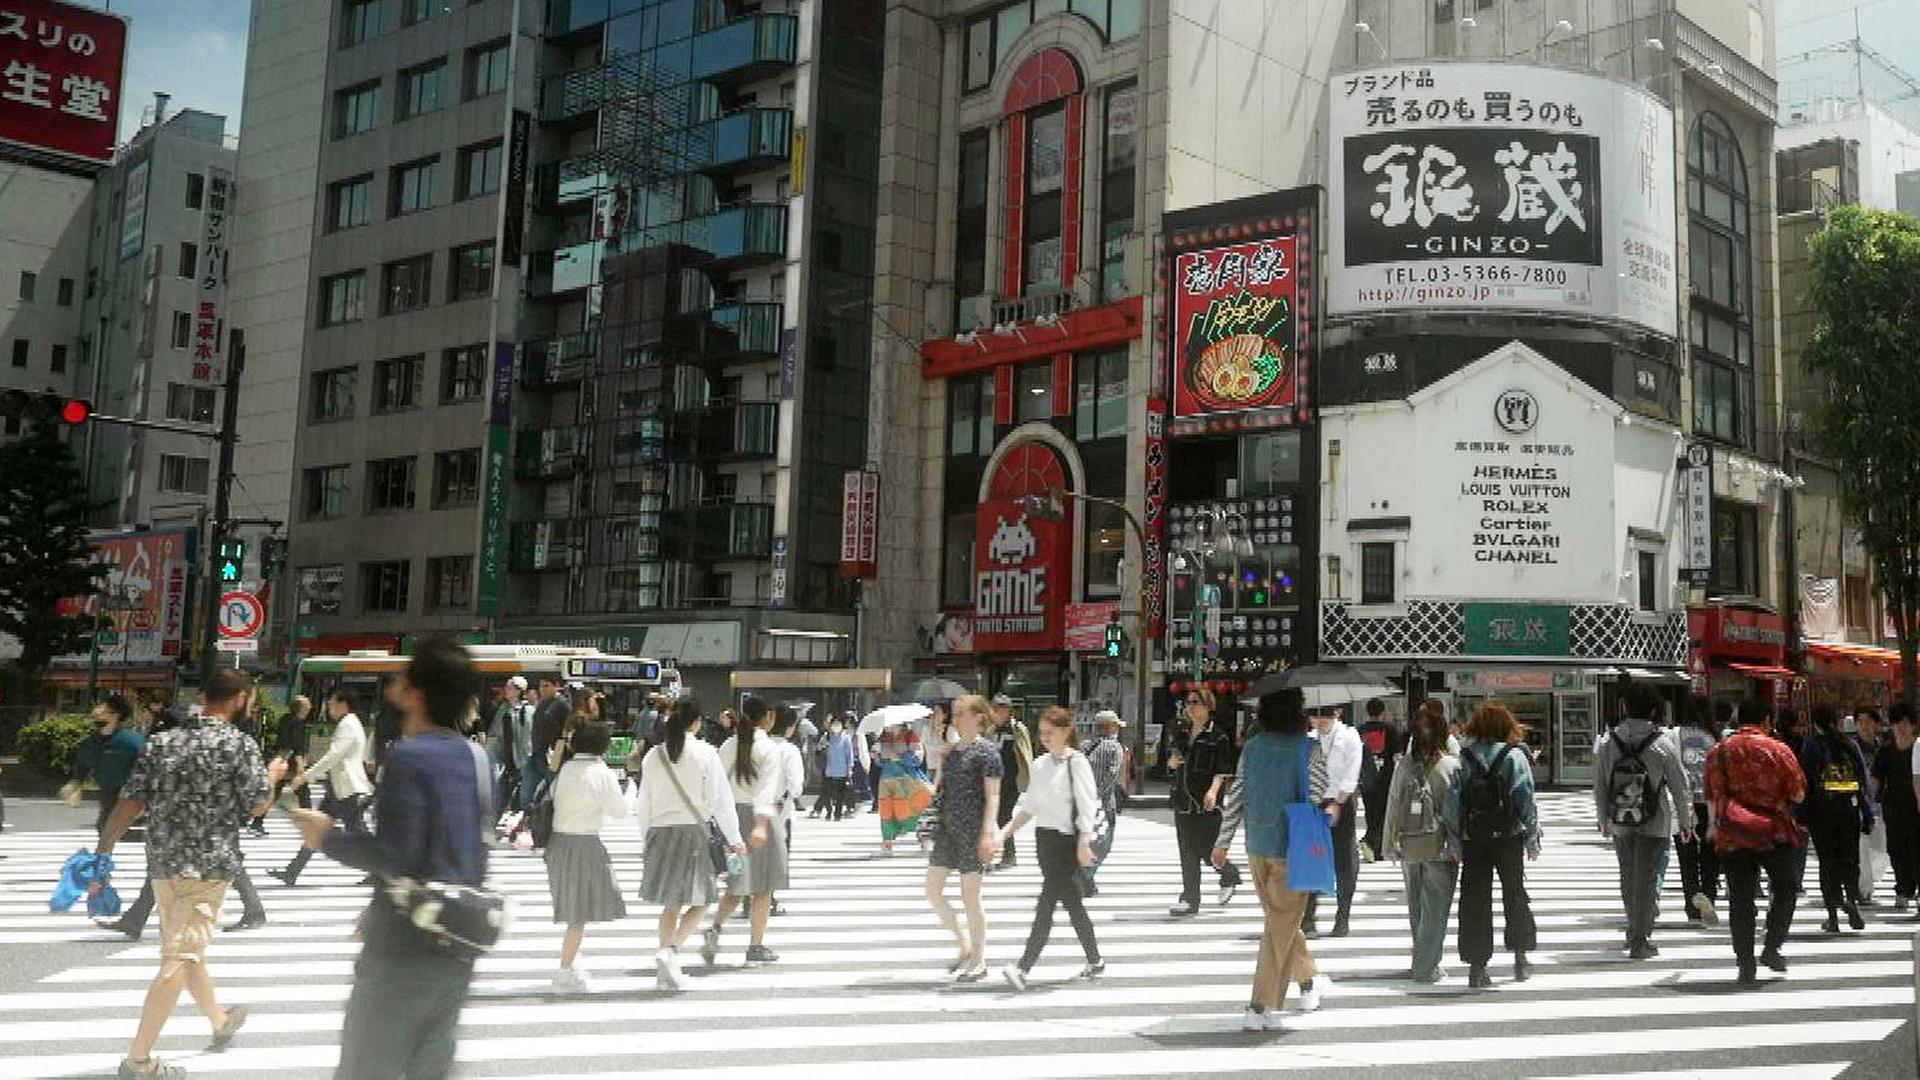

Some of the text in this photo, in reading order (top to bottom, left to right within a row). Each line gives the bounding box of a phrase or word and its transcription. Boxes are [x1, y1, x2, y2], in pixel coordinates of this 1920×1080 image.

[1344, 69, 1434, 96] ブランド品
[1358, 285, 1491, 303] http://ginzo.jp
[1461, 482, 1571, 498] LOUIS VUITTON
[1483, 500, 1549, 514] ROLEX
[1480, 517, 1551, 531] Cartier
[1473, 533, 1560, 548] BVLGARI
[1475, 550, 1558, 564] CHANEL
[976, 566, 1045, 616] GAME
[607, 637, 630, 651] LAB
